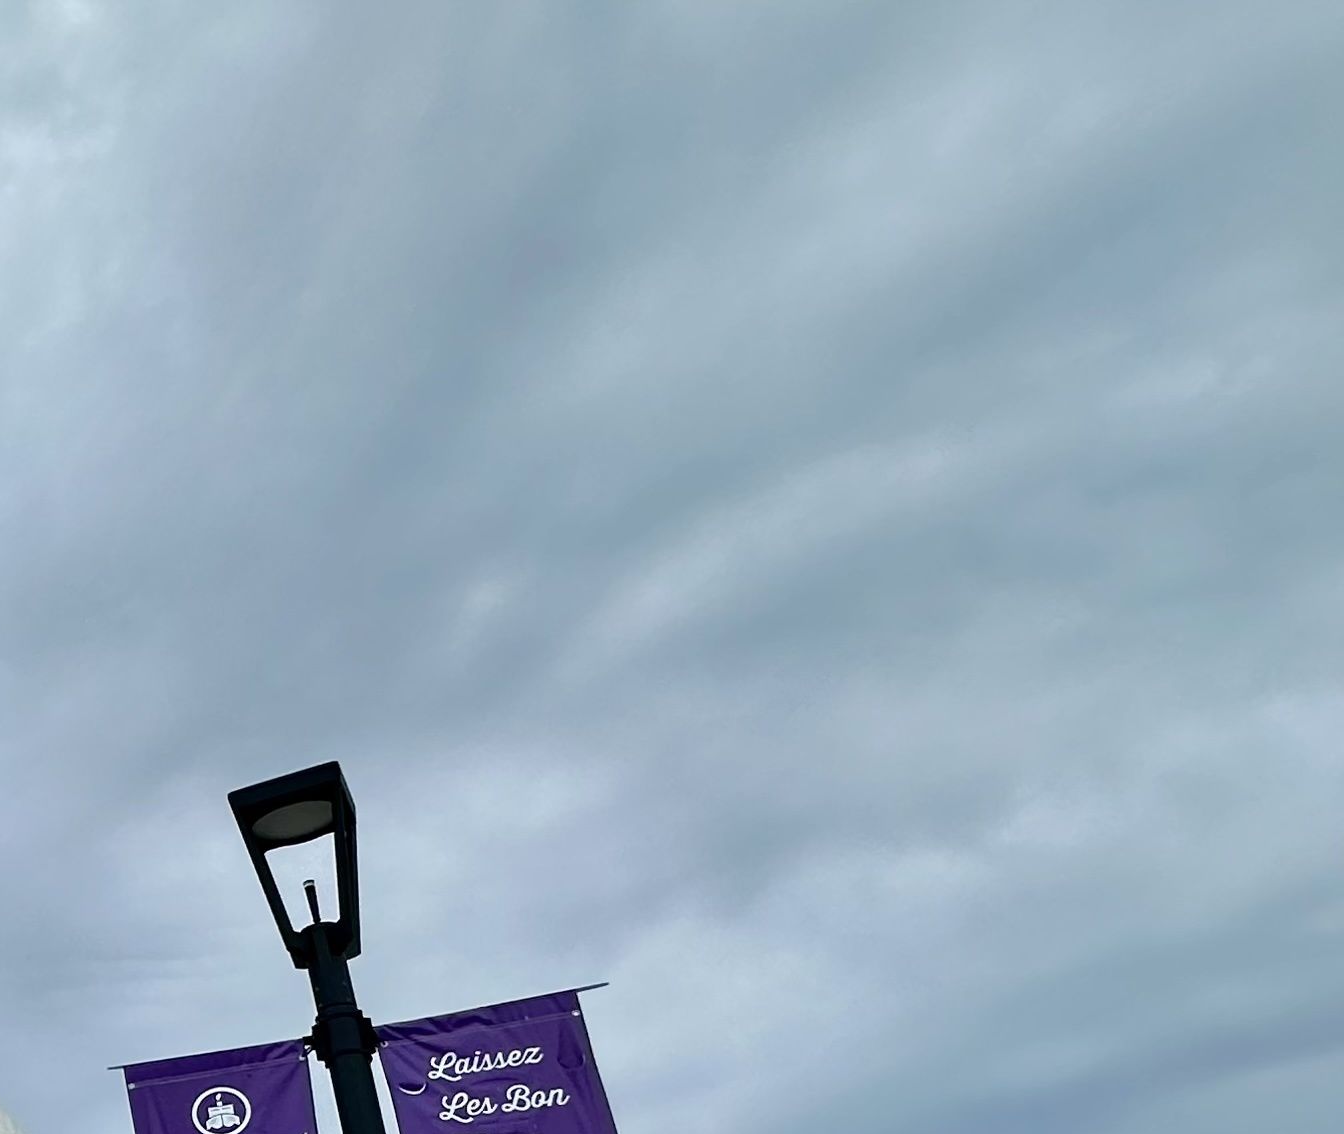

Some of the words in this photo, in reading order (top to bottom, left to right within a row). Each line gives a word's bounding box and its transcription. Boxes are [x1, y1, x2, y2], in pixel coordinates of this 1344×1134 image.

[428, 1046, 544, 1081] Laissez
[439, 1092, 498, 1123] Les
[501, 1084, 570, 1112] Bon
